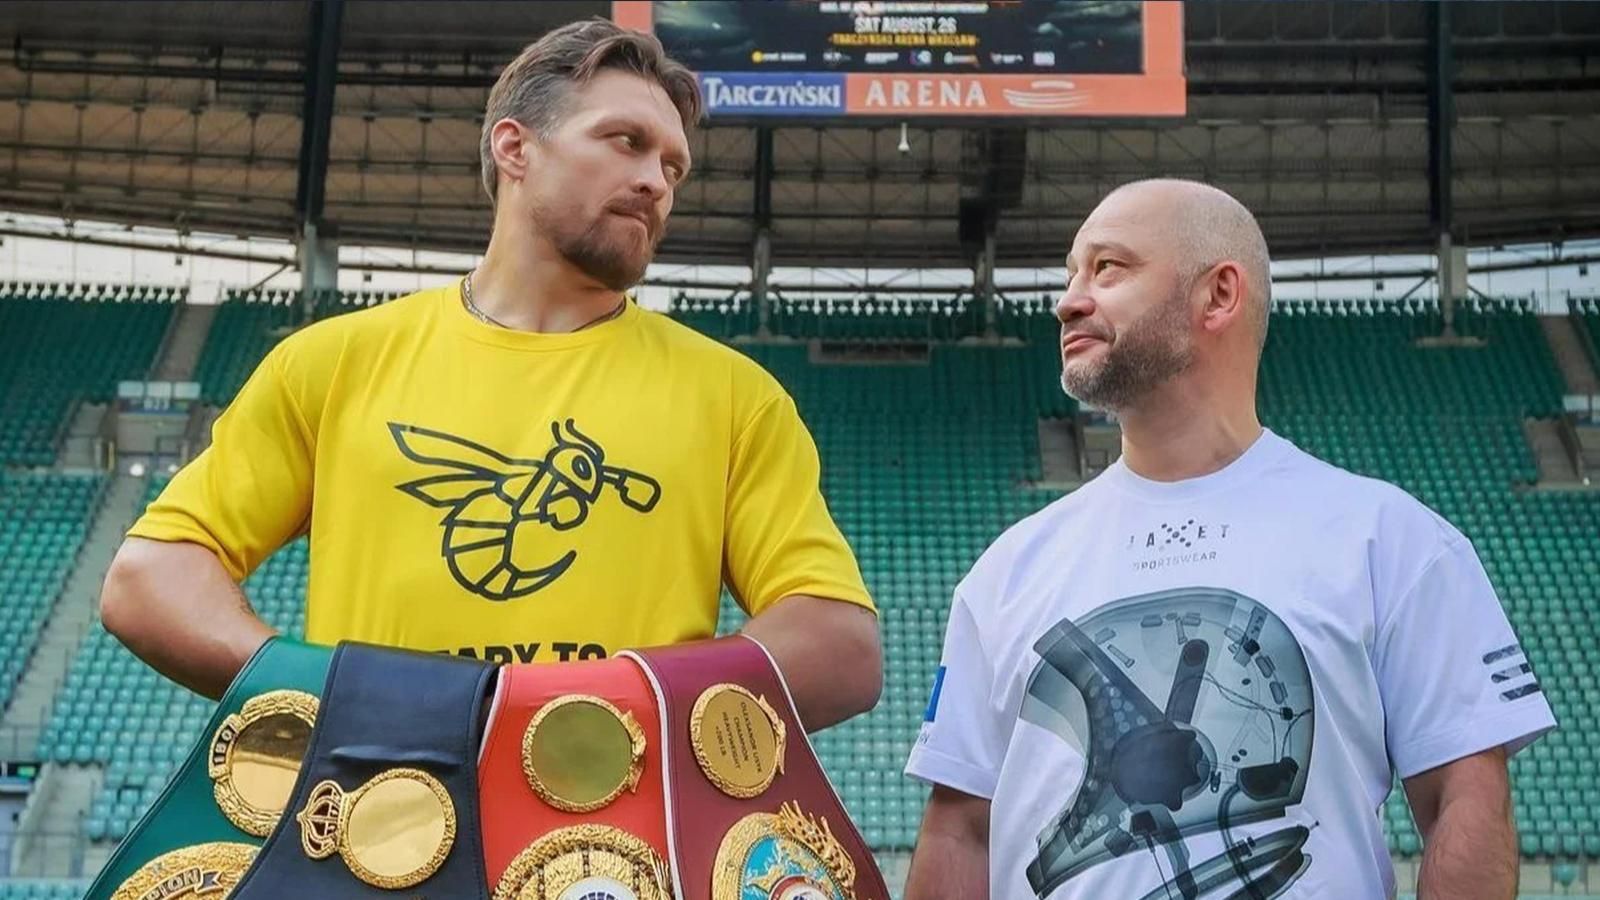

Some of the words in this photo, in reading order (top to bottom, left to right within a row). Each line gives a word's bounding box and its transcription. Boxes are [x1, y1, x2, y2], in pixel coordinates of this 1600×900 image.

[855, 16, 881, 33] SAT
[938, 16, 957, 33] 26
[703, 77, 840, 107] TARCZYŃSKI
[865, 80, 987, 107] ARENA
[1132, 551, 1217, 570] SPORTSWEAR
[213, 731, 232, 765] IBO
